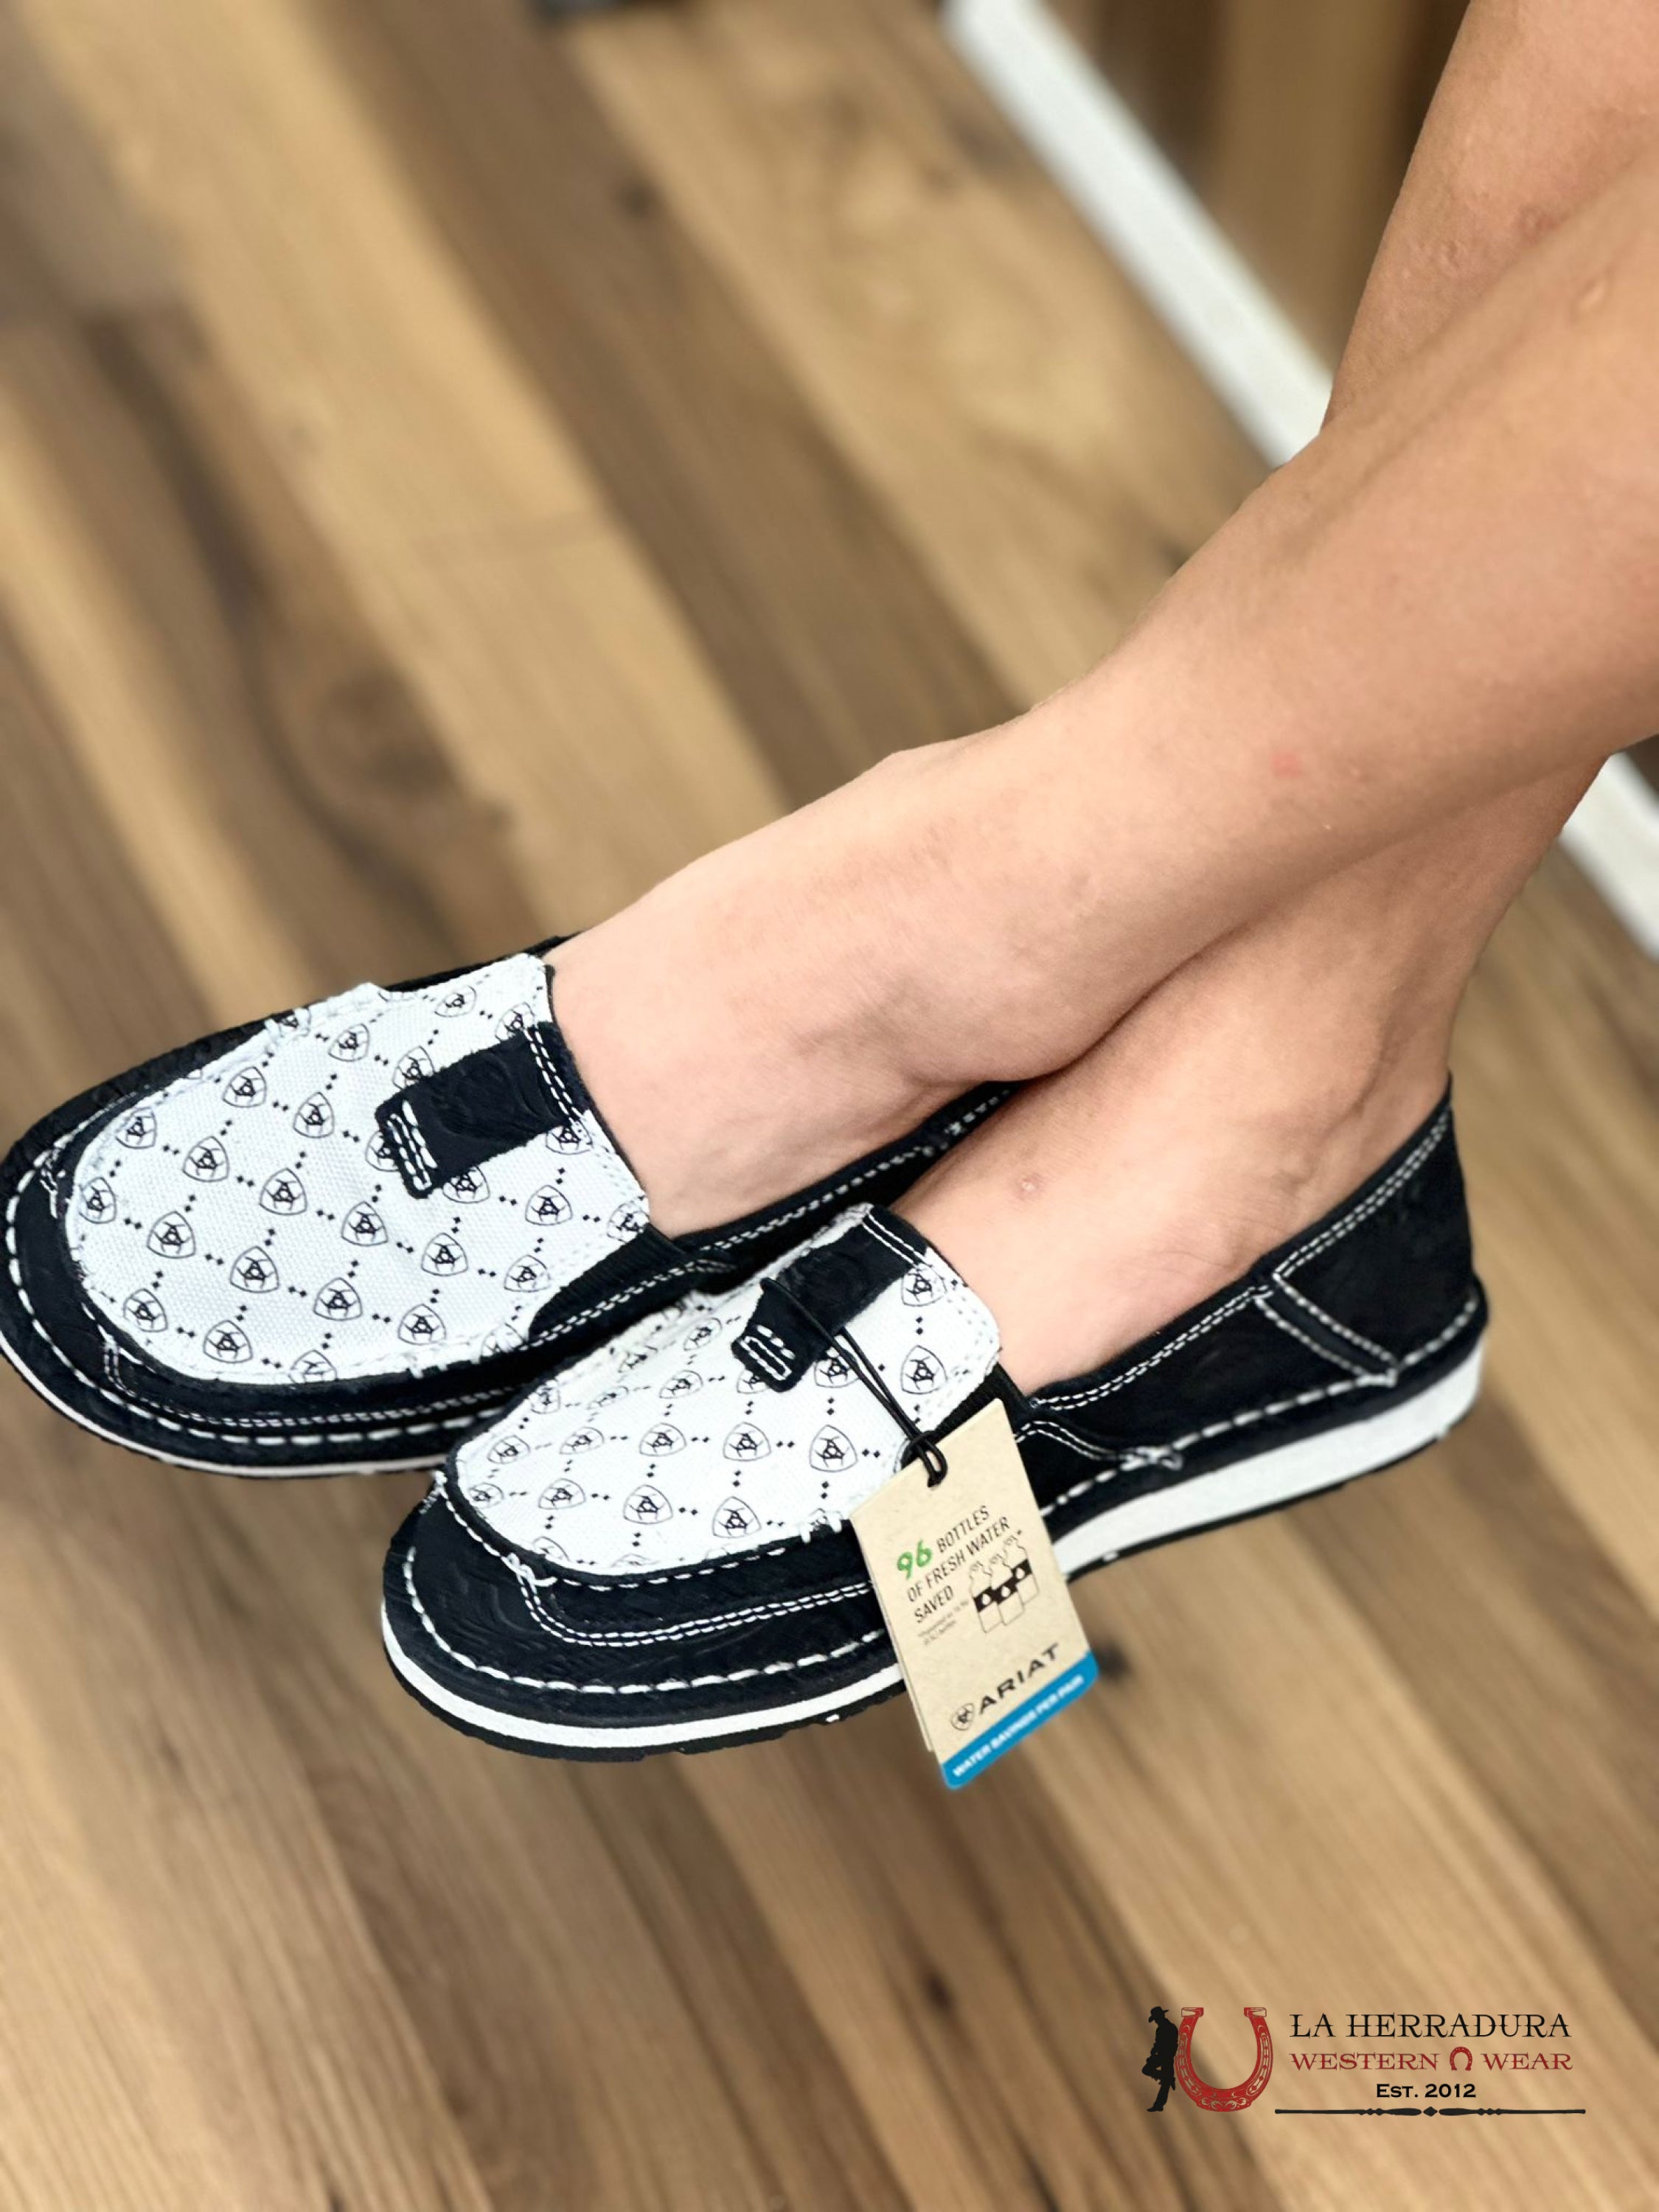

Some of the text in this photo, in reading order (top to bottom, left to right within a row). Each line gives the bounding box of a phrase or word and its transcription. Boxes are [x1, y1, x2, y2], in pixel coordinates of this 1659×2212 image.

[897, 1505, 990, 1580] 96 BOTTLES
[908, 1516, 1010, 1602] OF FRESH WATER
[914, 1585, 953, 1623] SAVED
[979, 1642, 1058, 1715] ARIAT
